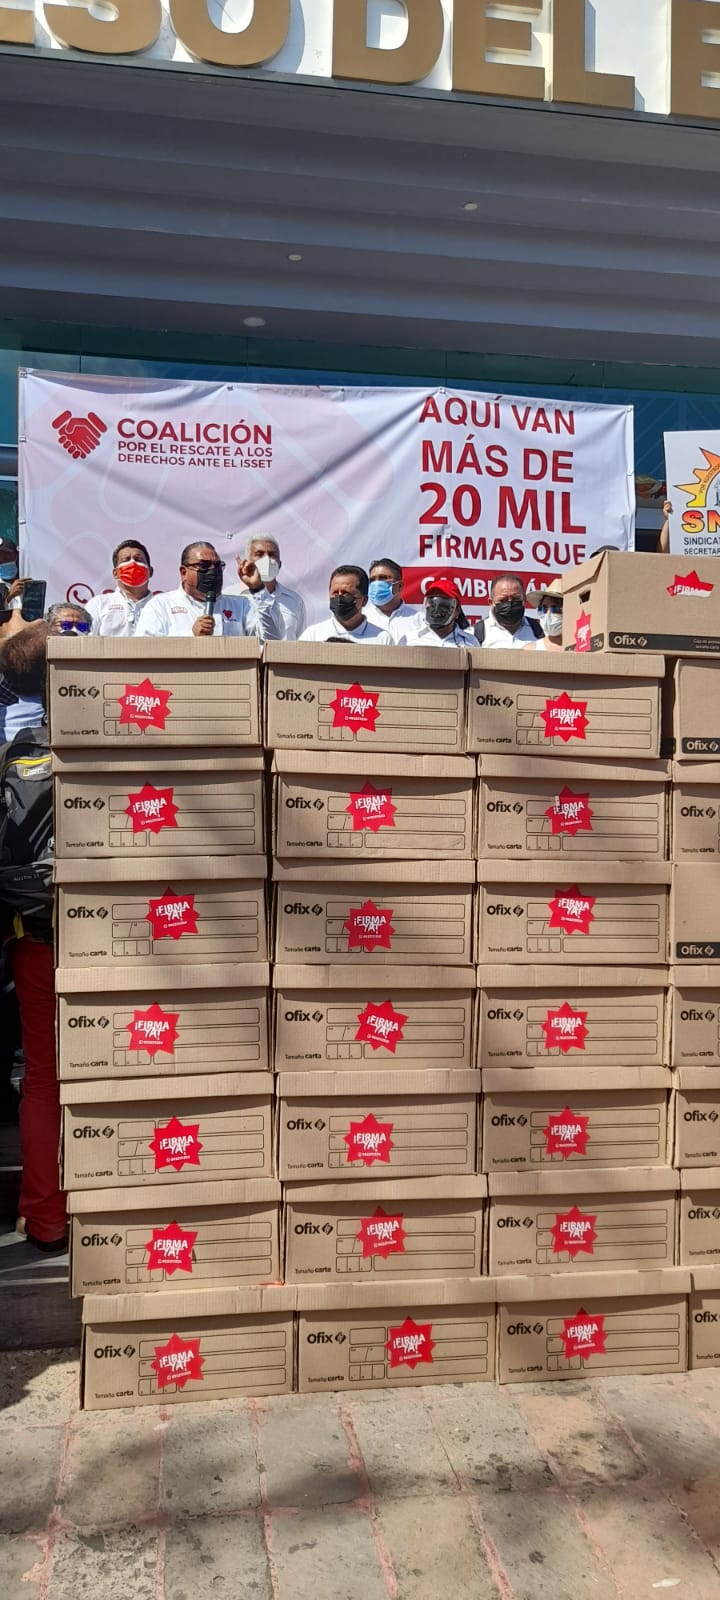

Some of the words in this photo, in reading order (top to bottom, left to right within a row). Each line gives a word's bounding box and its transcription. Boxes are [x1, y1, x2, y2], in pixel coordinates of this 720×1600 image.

[332, 0, 632, 108] DEL
[419, 396, 502, 429] AQUÍ
[511, 405, 575, 435] VAN
[117, 418, 272, 444] COALICIÓN
[118, 441, 146, 452] POR
[151, 443, 166, 453] EL
[170, 445, 230, 456] RESCATE
[234, 447, 244, 456] A
[248, 447, 273, 457] LOS
[118, 454, 185, 465] DERECHOS
[188, 458, 220, 467] ANTE
[224, 459, 237, 467] EL
[241, 460, 272, 468] ISSET
[422, 434, 509, 477] MÁS
[523, 448, 574, 483] DE
[419, 482, 482, 527] 20
[498, 486, 587, 534] MIL
[419, 535, 524, 562] FIRMAS
[532, 541, 586, 566] QUE
[614, 635, 636, 645] Ofix
[58, 685, 86, 697] Ofix
[276, 689, 301, 701] Ofix
[126, 694, 160, 706] ¡FIRMA
[340, 697, 373, 708] ¡FIRMA
[476, 695, 501, 706] Ofix
[136, 703, 153, 715] YA!
[351, 705, 365, 716] YA!
[550, 709, 581, 719] ¡FIRMA
[559, 716, 575, 726] YA!
[686, 741, 708, 750] Ofix
[64, 798, 91, 809] Ofix
[133, 798, 167, 813] ¡FIRMA
[286, 798, 311, 809] Ofix
[355, 795, 387, 809] ¡FIRMA
[487, 801, 511, 812] Ofix
[553, 801, 584, 814] ¡FIRMA
[144, 808, 160, 817] YA!
[366, 804, 382, 814] YA!
[564, 809, 579, 820] YA!
[681, 807, 704, 817] Ofix
[156, 901, 190, 917] ¡FIRMA
[284, 903, 309, 915] Ofix
[558, 898, 589, 909] ¡FIRMA
[67, 907, 94, 919] Ofix
[487, 904, 511, 915] Ofix
[567, 907, 582, 918] YA!
[167, 911, 183, 921] YA!
[354, 916, 386, 926] ¡FIRMA
[364, 923, 379, 933] YA!
[681, 946, 703, 955] Ofix
[285, 1011, 310, 1022] Ofix
[487, 1009, 511, 1020] Ofix
[680, 1010, 703, 1020] Ofix
[68, 1016, 95, 1028] Ofix
[135, 1021, 169, 1031] ¡FIRMA
[366, 1015, 398, 1031] ¡FIRMA
[551, 1017, 582, 1027] ¡FIRMA
[145, 1029, 160, 1041] YA!
[375, 1024, 389, 1038] YA!
[561, 1025, 575, 1036] YA!
[491, 1115, 515, 1126] Ofix
[684, 1110, 707, 1121] Ofix
[287, 1119, 312, 1130] Ofix
[551, 1124, 582, 1135] ¡FIRMA
[73, 1126, 100, 1138] Ofix
[560, 1132, 574, 1143] YA!
[160, 1135, 194, 1149] ¡FIRMA
[354, 1133, 386, 1144] ¡FIRMA
[171, 1144, 186, 1155] YA!
[364, 1141, 378, 1152] YA!
[688, 1208, 710, 1219] Ofix
[367, 1220, 399, 1235] ¡FIRMA
[497, 1217, 520, 1228] Ofix
[560, 1222, 591, 1232] ¡FIRMA
[295, 1223, 320, 1235] Ofix
[569, 1230, 583, 1239] YA!
[81, 1234, 109, 1247] Ofix
[377, 1230, 393, 1240] YA!
[154, 1240, 188, 1250] ¡FIRMA
[163, 1248, 179, 1259] YA!
[695, 1311, 718, 1323] Ofix
[507, 1323, 531, 1335] Ofix
[567, 1324, 598, 1337] ¡FIRMA
[307, 1332, 333, 1344] Ofix
[393, 1334, 426, 1349] ¡FIRMA
[577, 1332, 592, 1342] YA!
[94, 1345, 122, 1359] Ofix
[404, 1344, 418, 1354] YA!
[159, 1350, 194, 1368] ¡FIRMA
[171, 1360, 188, 1371] YA!
